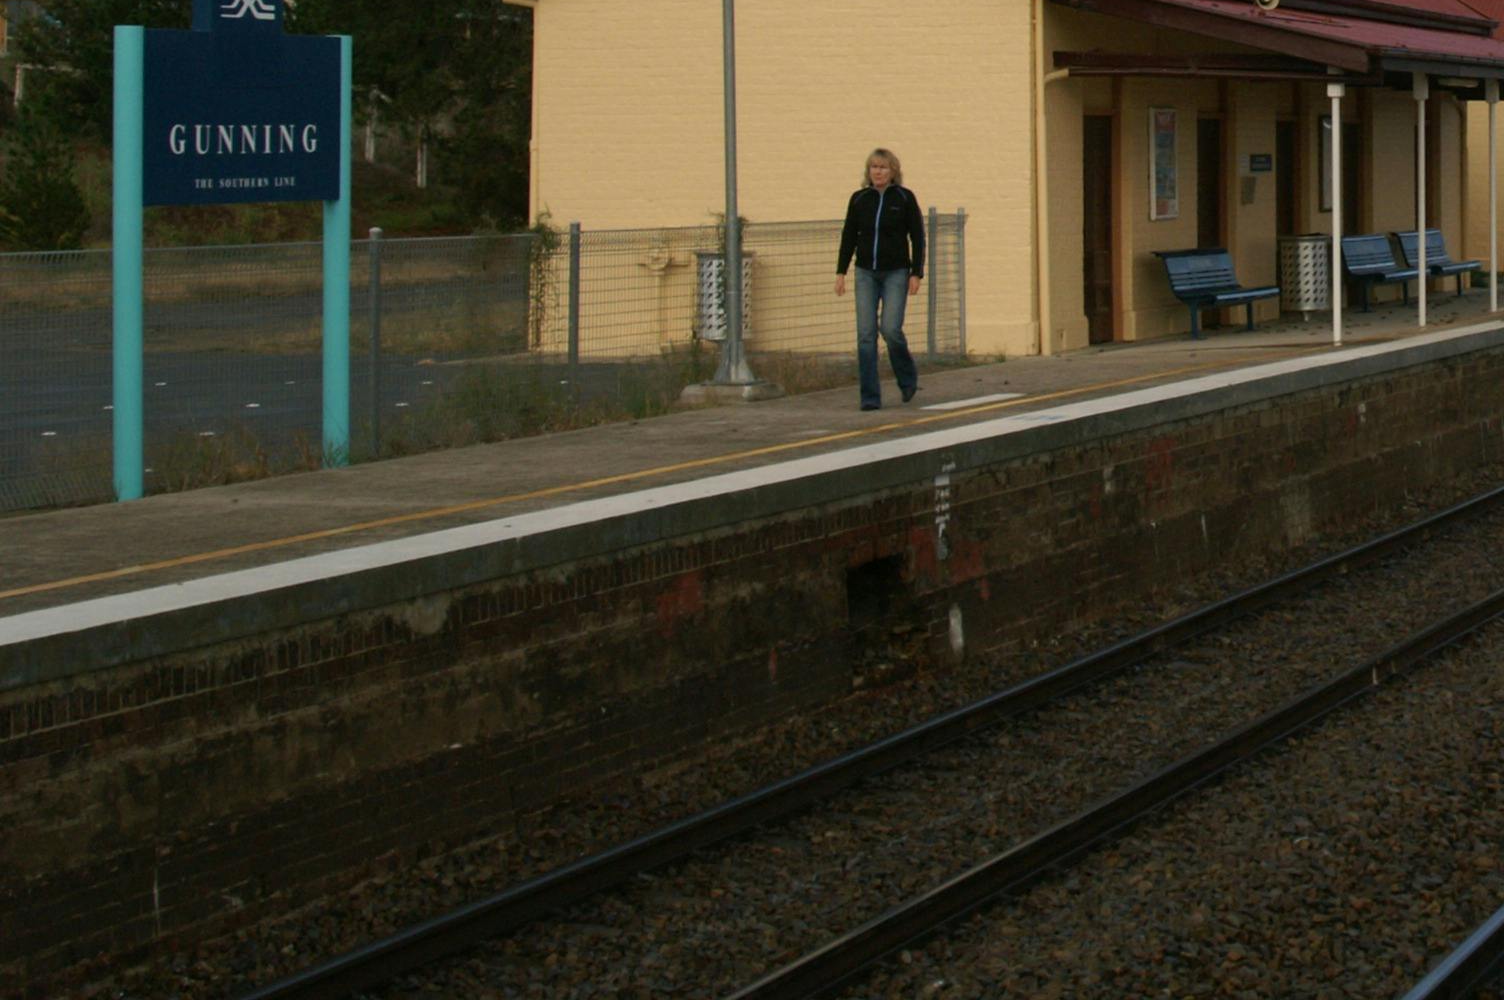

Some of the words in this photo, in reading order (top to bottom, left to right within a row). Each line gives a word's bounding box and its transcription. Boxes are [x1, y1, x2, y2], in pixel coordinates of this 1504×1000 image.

[169, 124, 318, 155] GUNNING
[194, 178, 213, 189] THE
[219, 177, 269, 188] SOUTHERN
[274, 176, 296, 187] LINE
